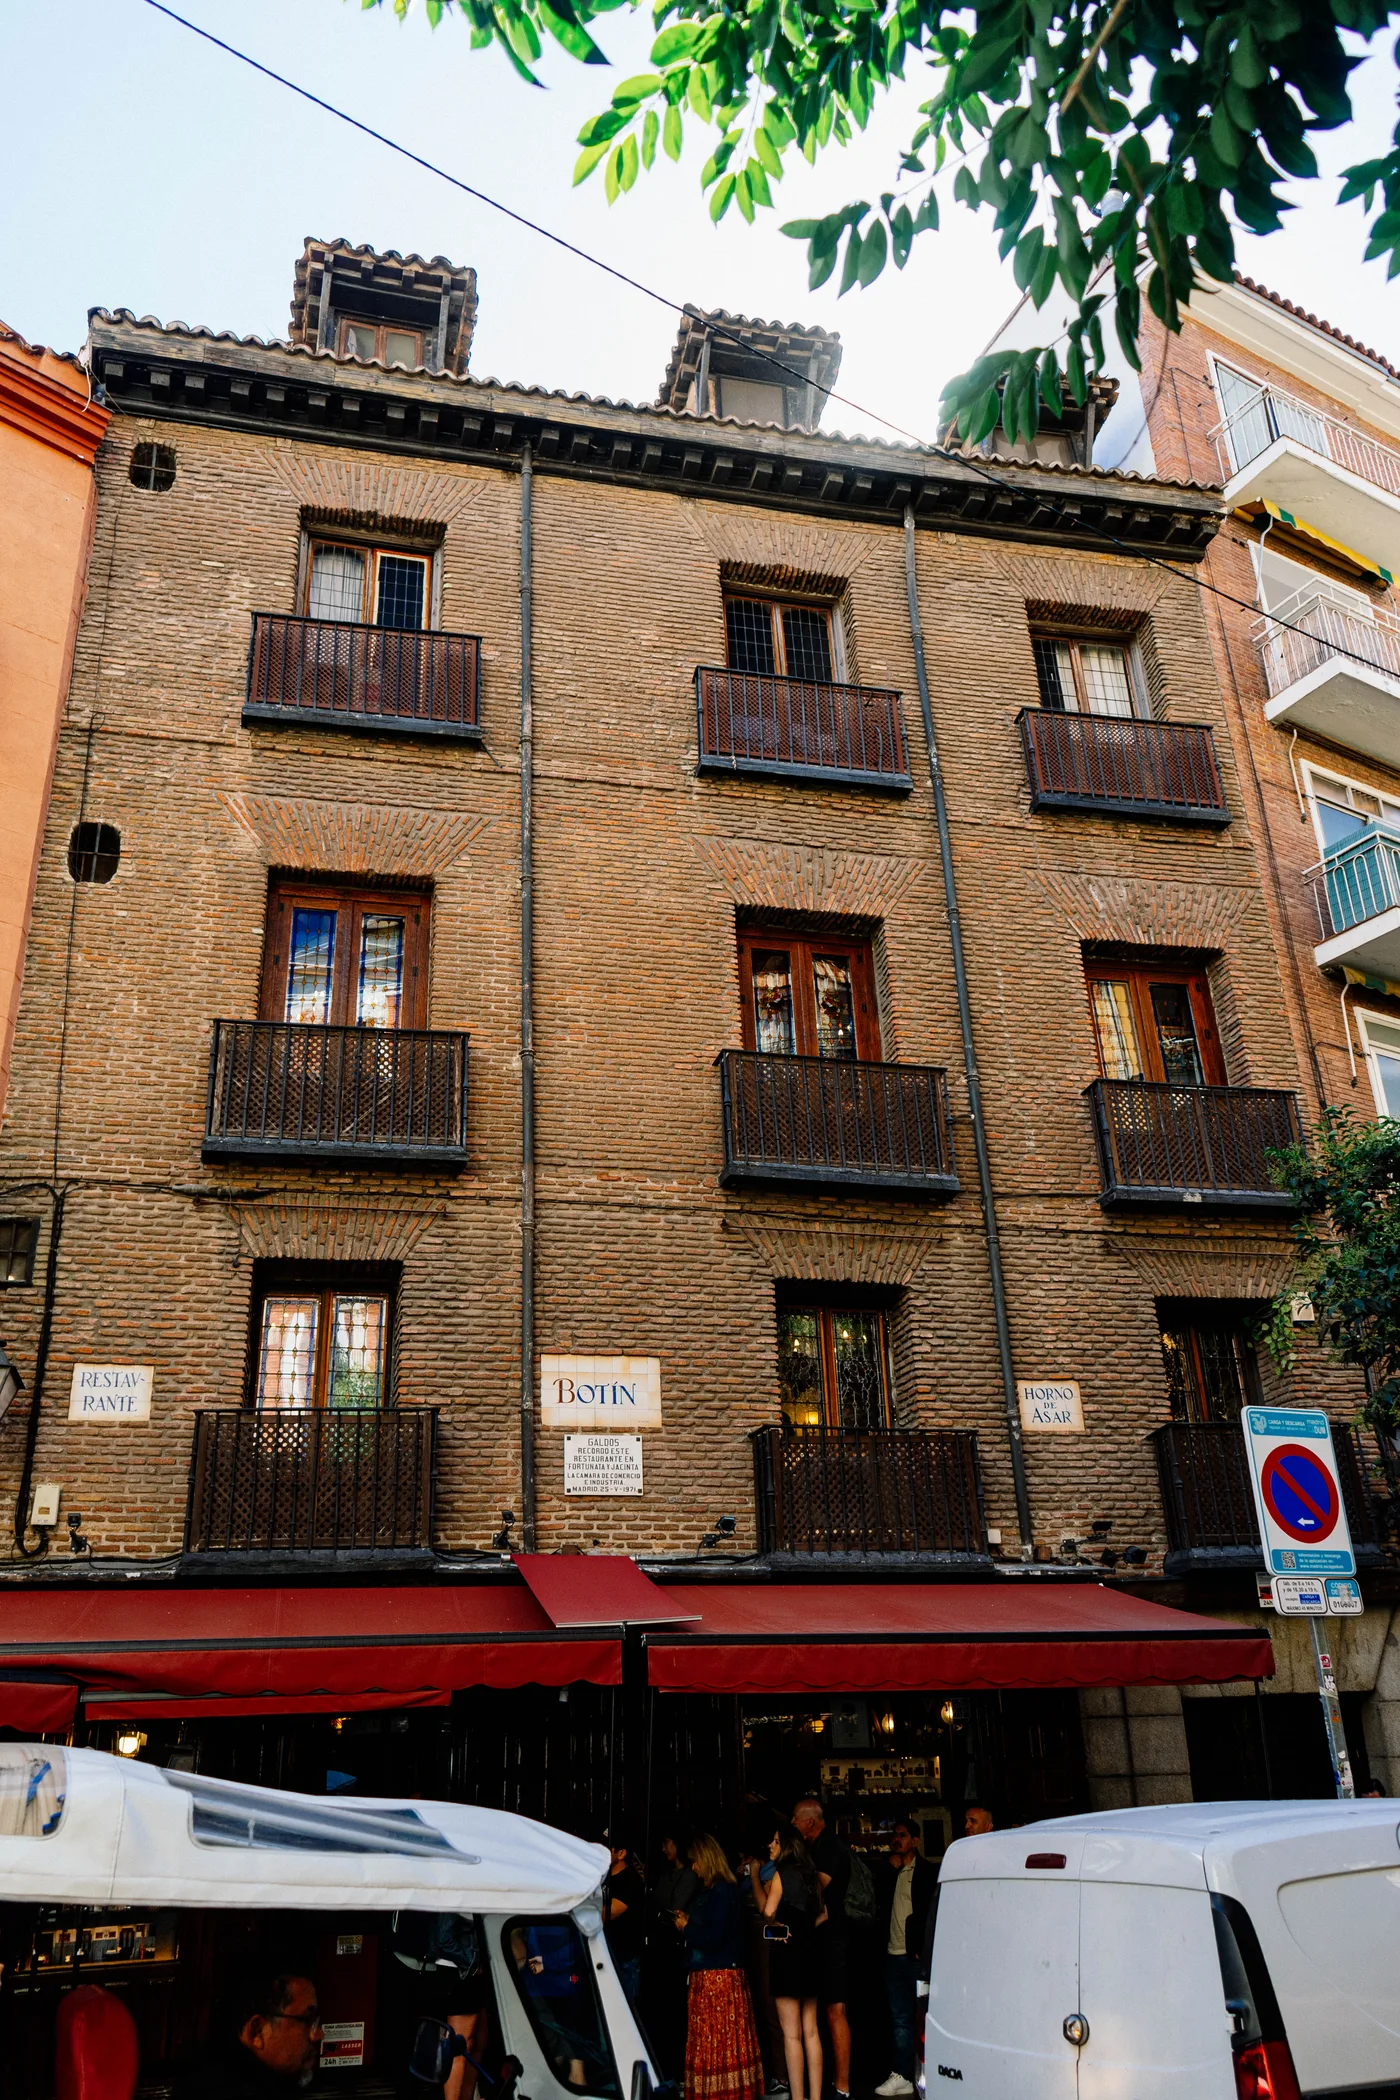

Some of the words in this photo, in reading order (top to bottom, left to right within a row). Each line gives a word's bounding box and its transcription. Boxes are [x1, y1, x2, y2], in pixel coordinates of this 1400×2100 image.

[1024, 1387, 1074, 1400] HORNO
[82, 1394, 137, 1412] RANTE
[1032, 1408, 1073, 1424] ASAR
[588, 1438, 620, 1446] GALDOS
[938, 2064, 964, 2081] DACIA
